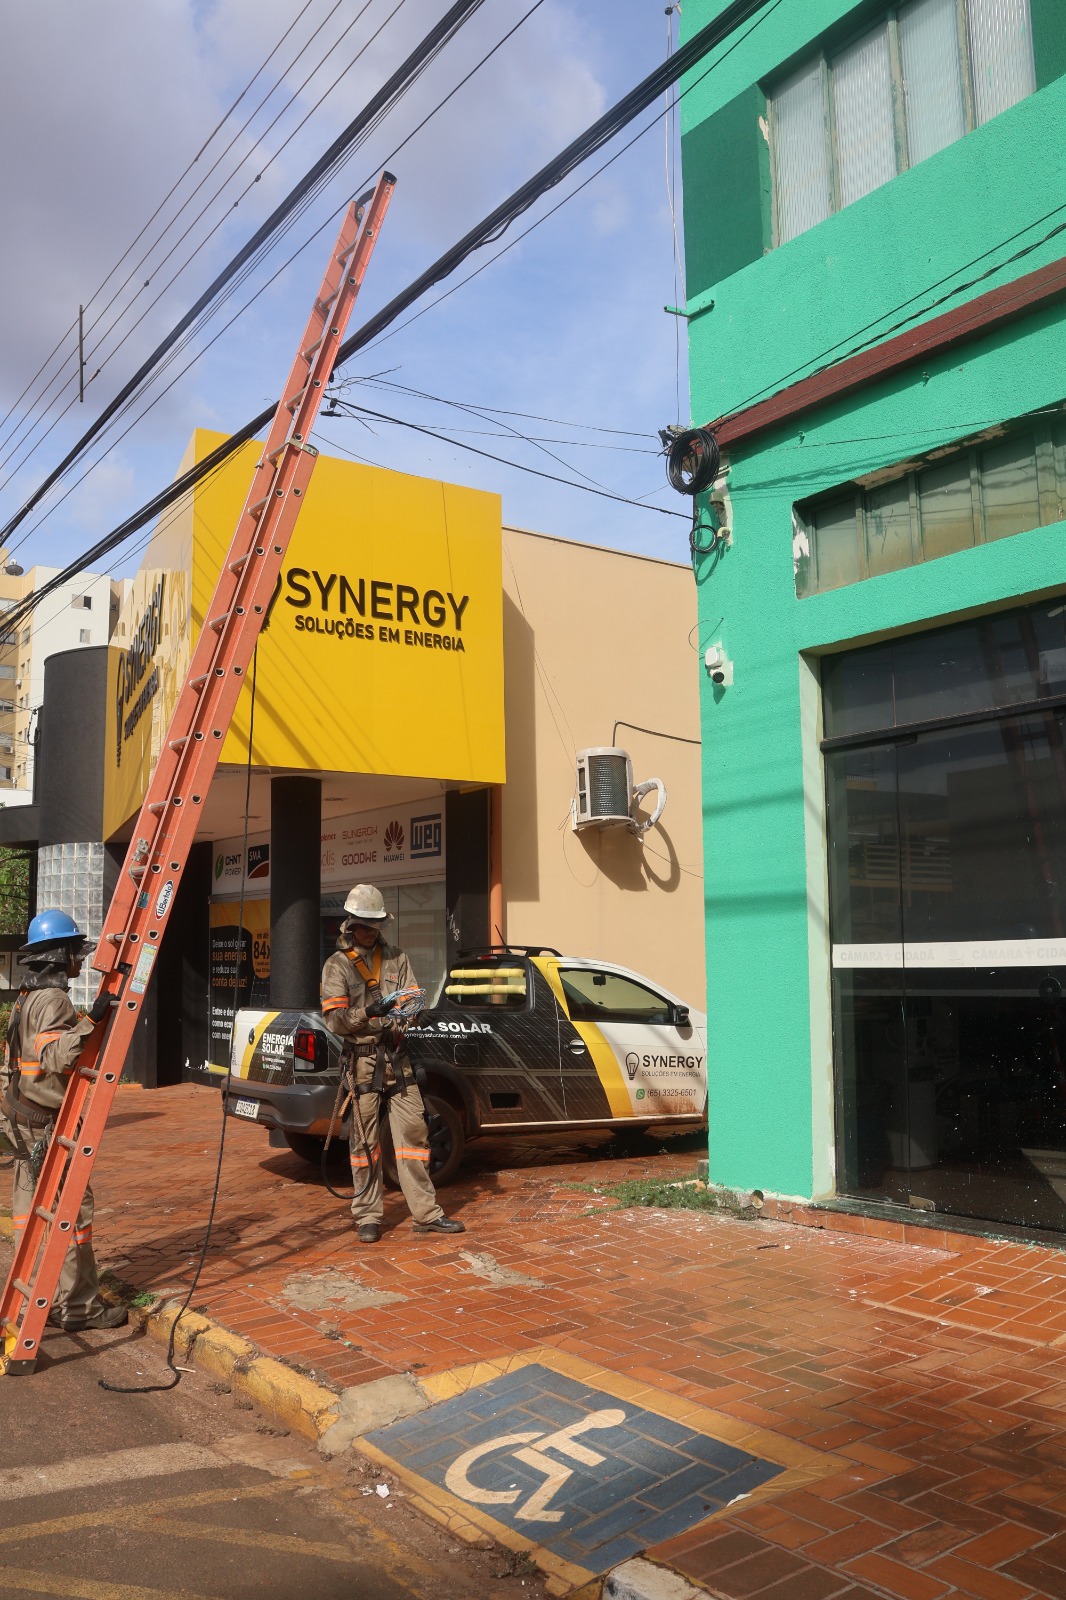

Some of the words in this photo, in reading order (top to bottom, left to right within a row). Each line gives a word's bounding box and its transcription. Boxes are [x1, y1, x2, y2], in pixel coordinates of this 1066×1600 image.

[285, 567, 469, 630] SYNERGY
[295, 614, 374, 640] SOLUÇÕES
[379, 626, 400, 644] EM
[404, 629, 465, 652] ENERGIA
[341, 851, 377, 866] GOODWE
[384, 853, 405, 863] HUAWEI
[437, 1021, 493, 1034] SOLAR
[262, 1032, 294, 1047] ENERGIA
[261, 1042, 285, 1056] SOLAR
[642, 1054, 703, 1069] SYNERGY
